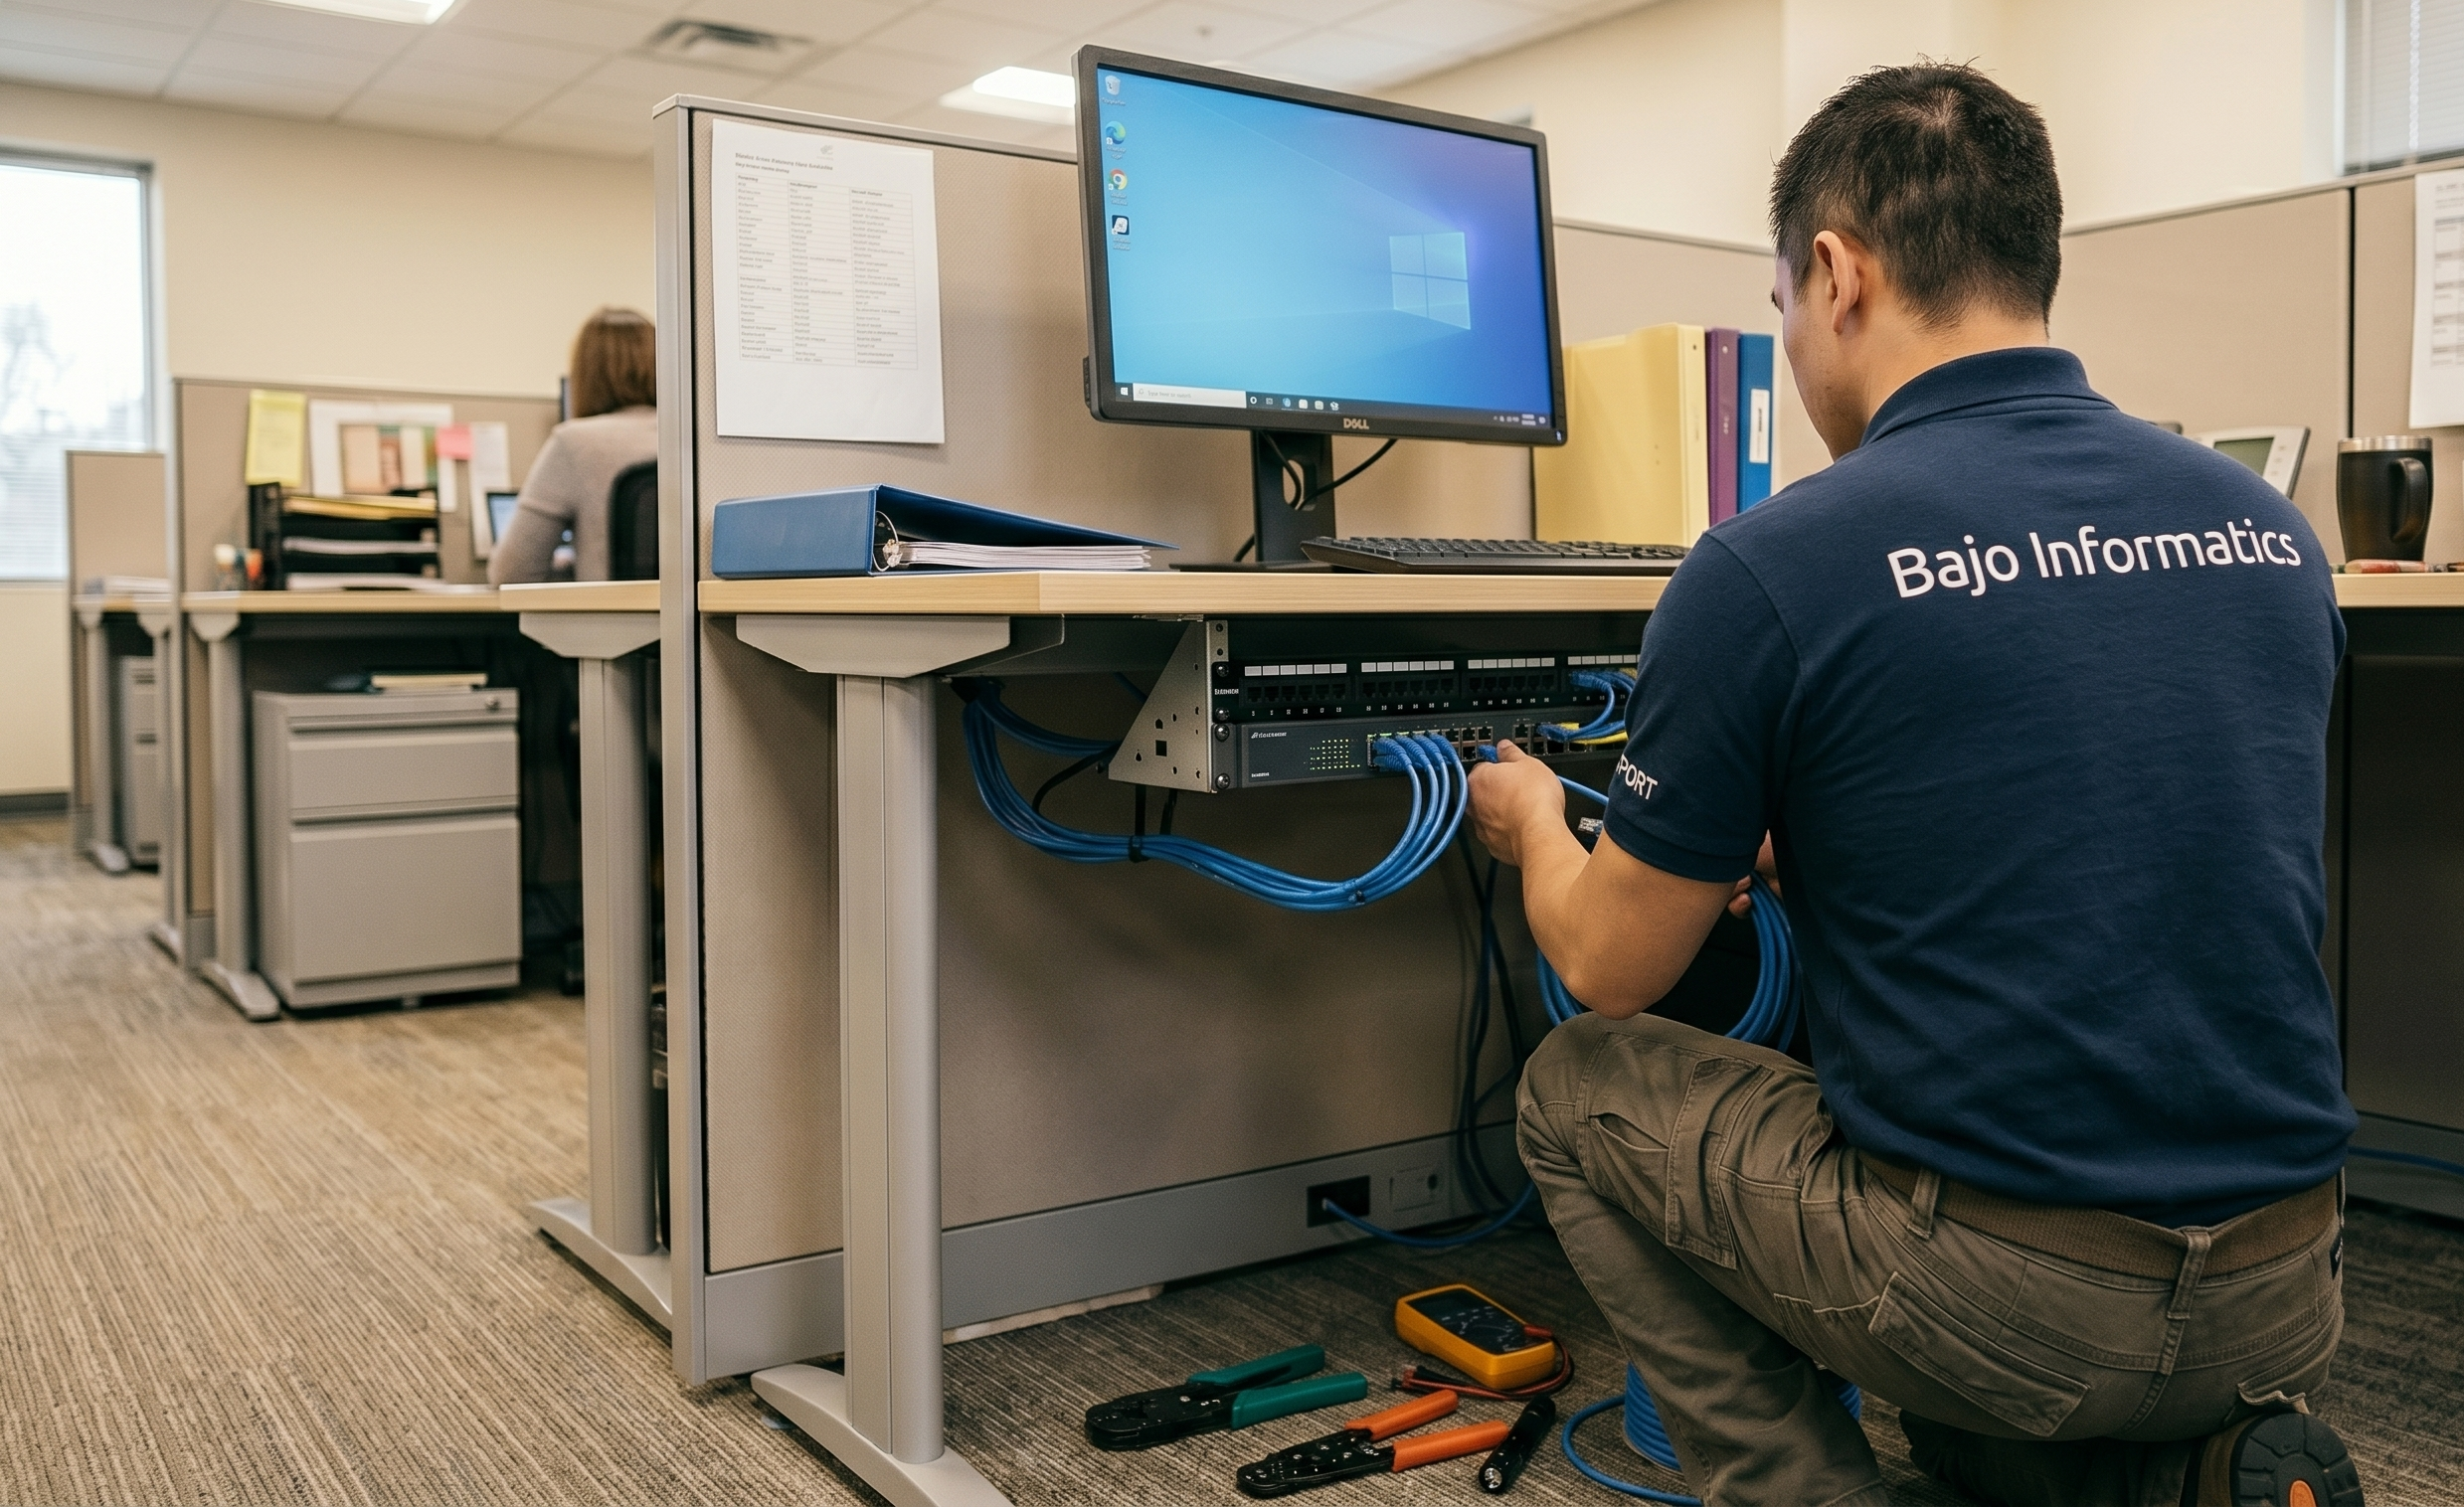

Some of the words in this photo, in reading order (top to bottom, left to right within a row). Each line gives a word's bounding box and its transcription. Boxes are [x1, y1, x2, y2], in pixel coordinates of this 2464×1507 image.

[1343, 418, 1370, 430] DELL
[1887, 535, 2020, 597] Bajo
[2029, 518, 2301, 578] Informatics
[1615, 754, 1658, 800] PORT
